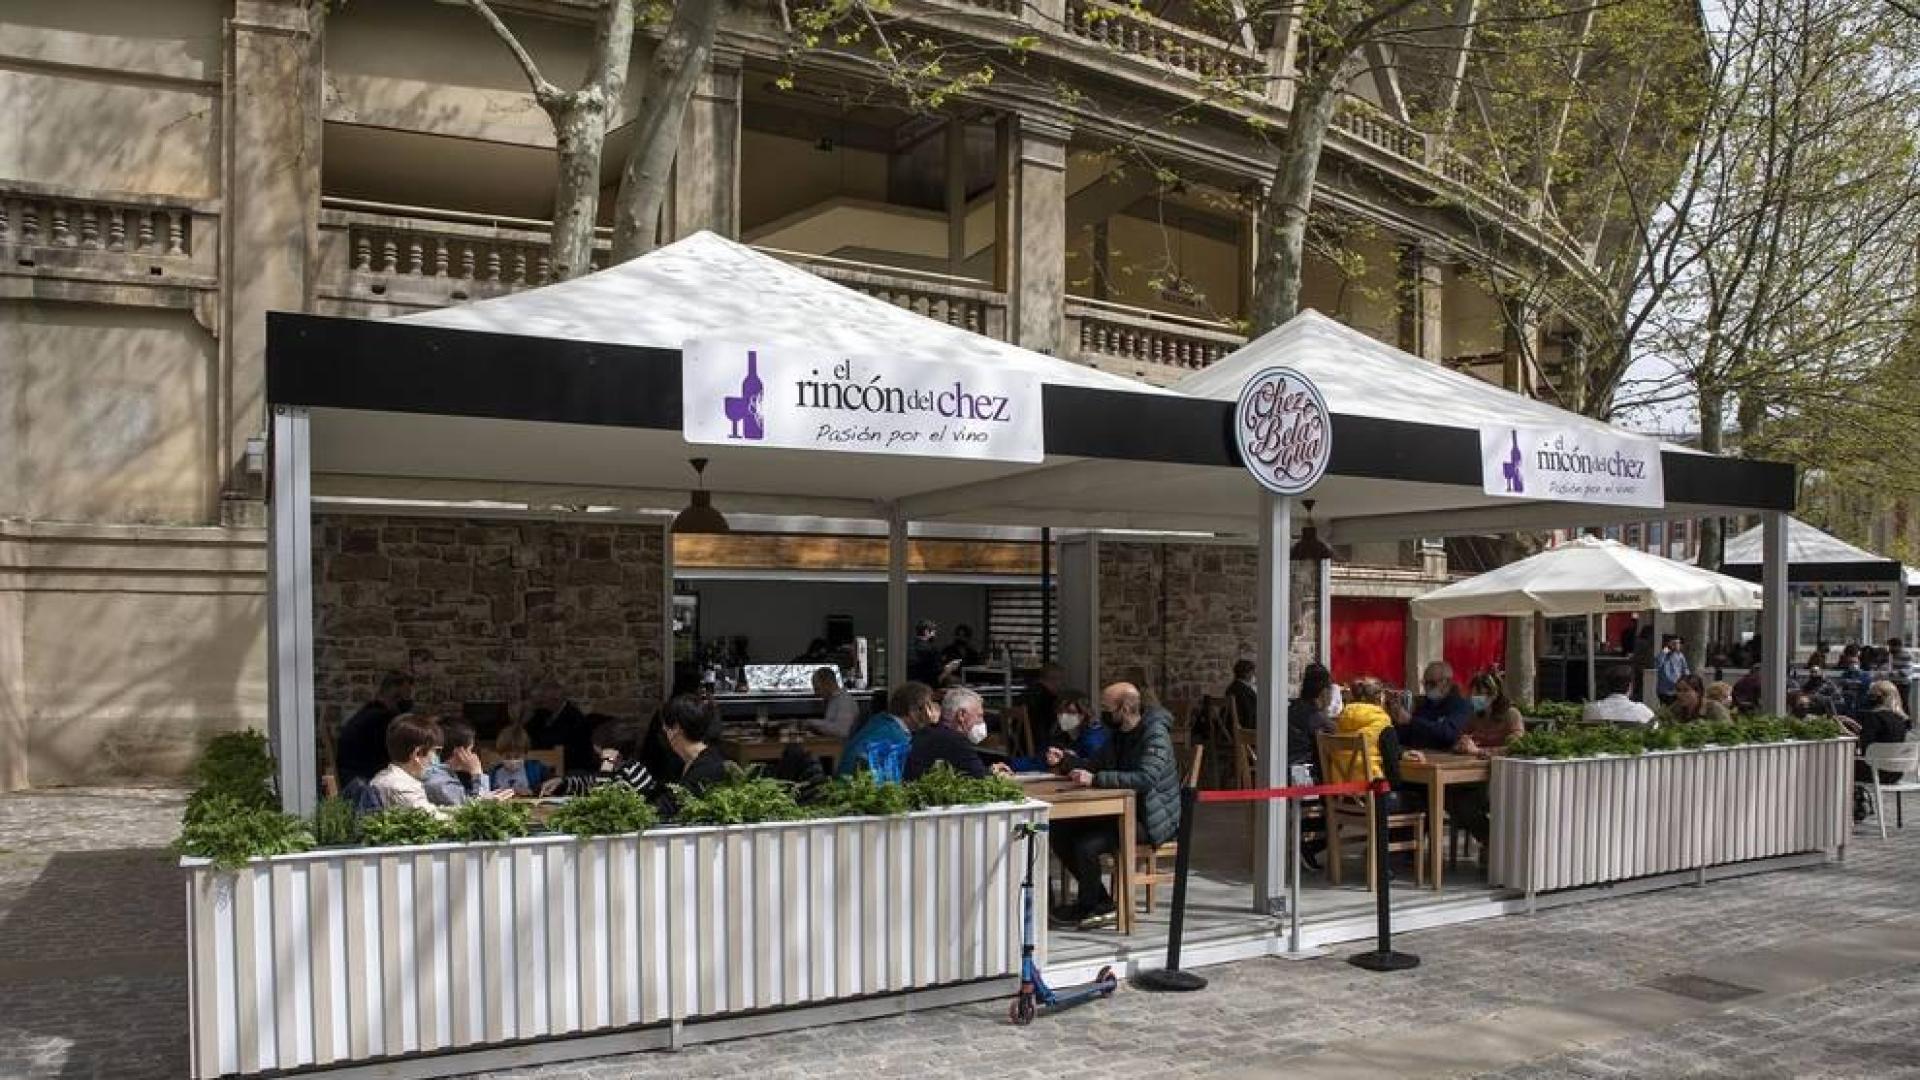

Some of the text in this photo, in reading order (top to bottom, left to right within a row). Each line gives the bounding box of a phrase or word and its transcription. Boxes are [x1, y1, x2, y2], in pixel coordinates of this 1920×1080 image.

[833, 359, 850, 380] el
[795, 369, 1010, 421] rincón del chez
[1245, 378, 1309, 426] Chez
[816, 423, 988, 447] Pasión por el vino
[1537, 444, 1593, 474] rincón
[1607, 450, 1646, 480] chez
